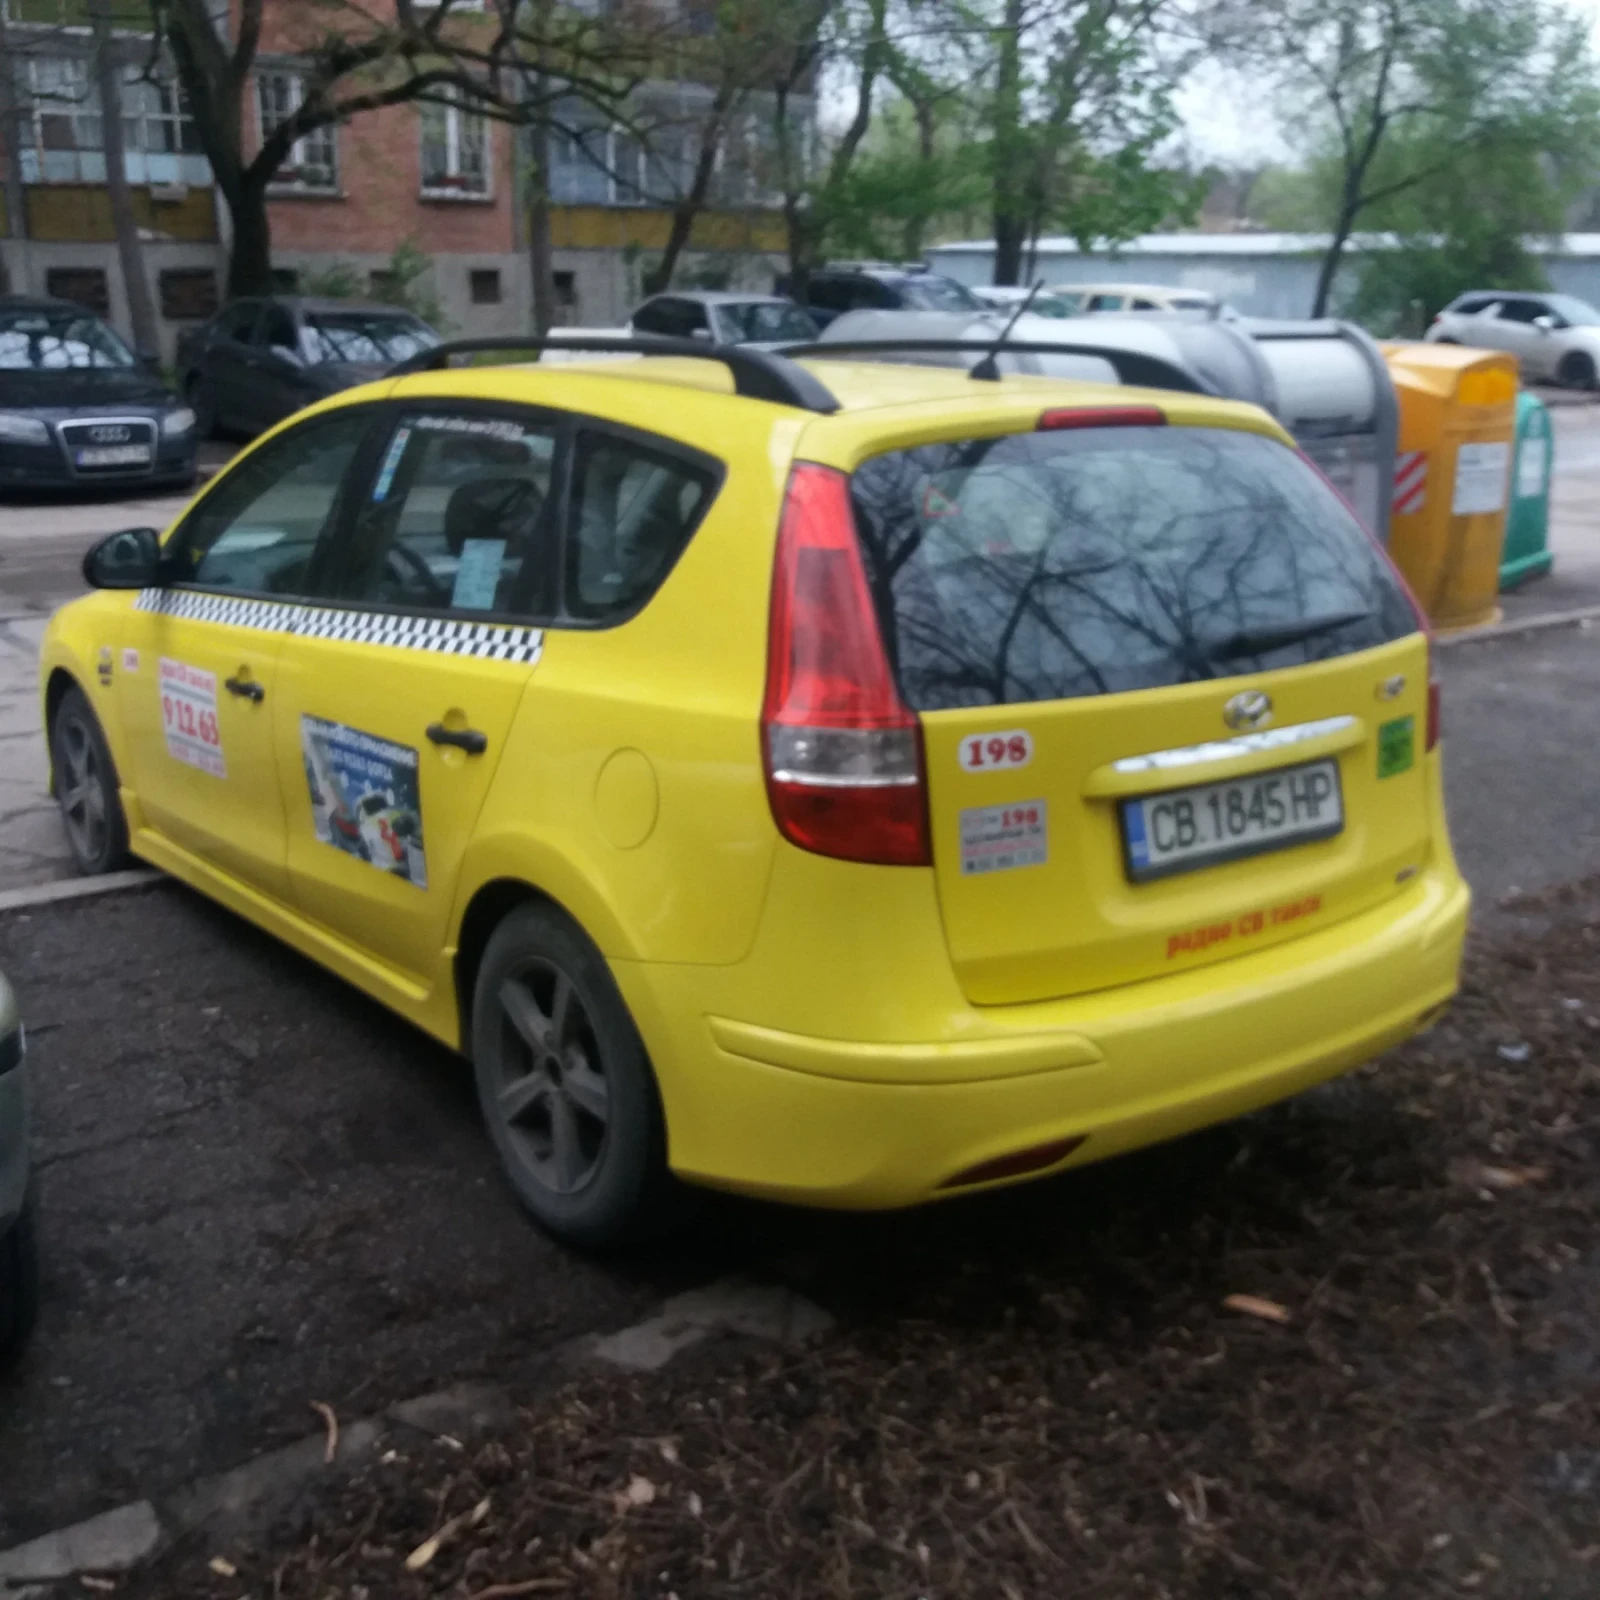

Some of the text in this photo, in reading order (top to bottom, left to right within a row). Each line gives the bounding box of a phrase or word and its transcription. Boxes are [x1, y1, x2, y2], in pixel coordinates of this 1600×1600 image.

[967, 735, 1027, 767] 198
[1002, 807, 1039, 829] 198
[1151, 771, 1331, 852] CB 1845 HP
